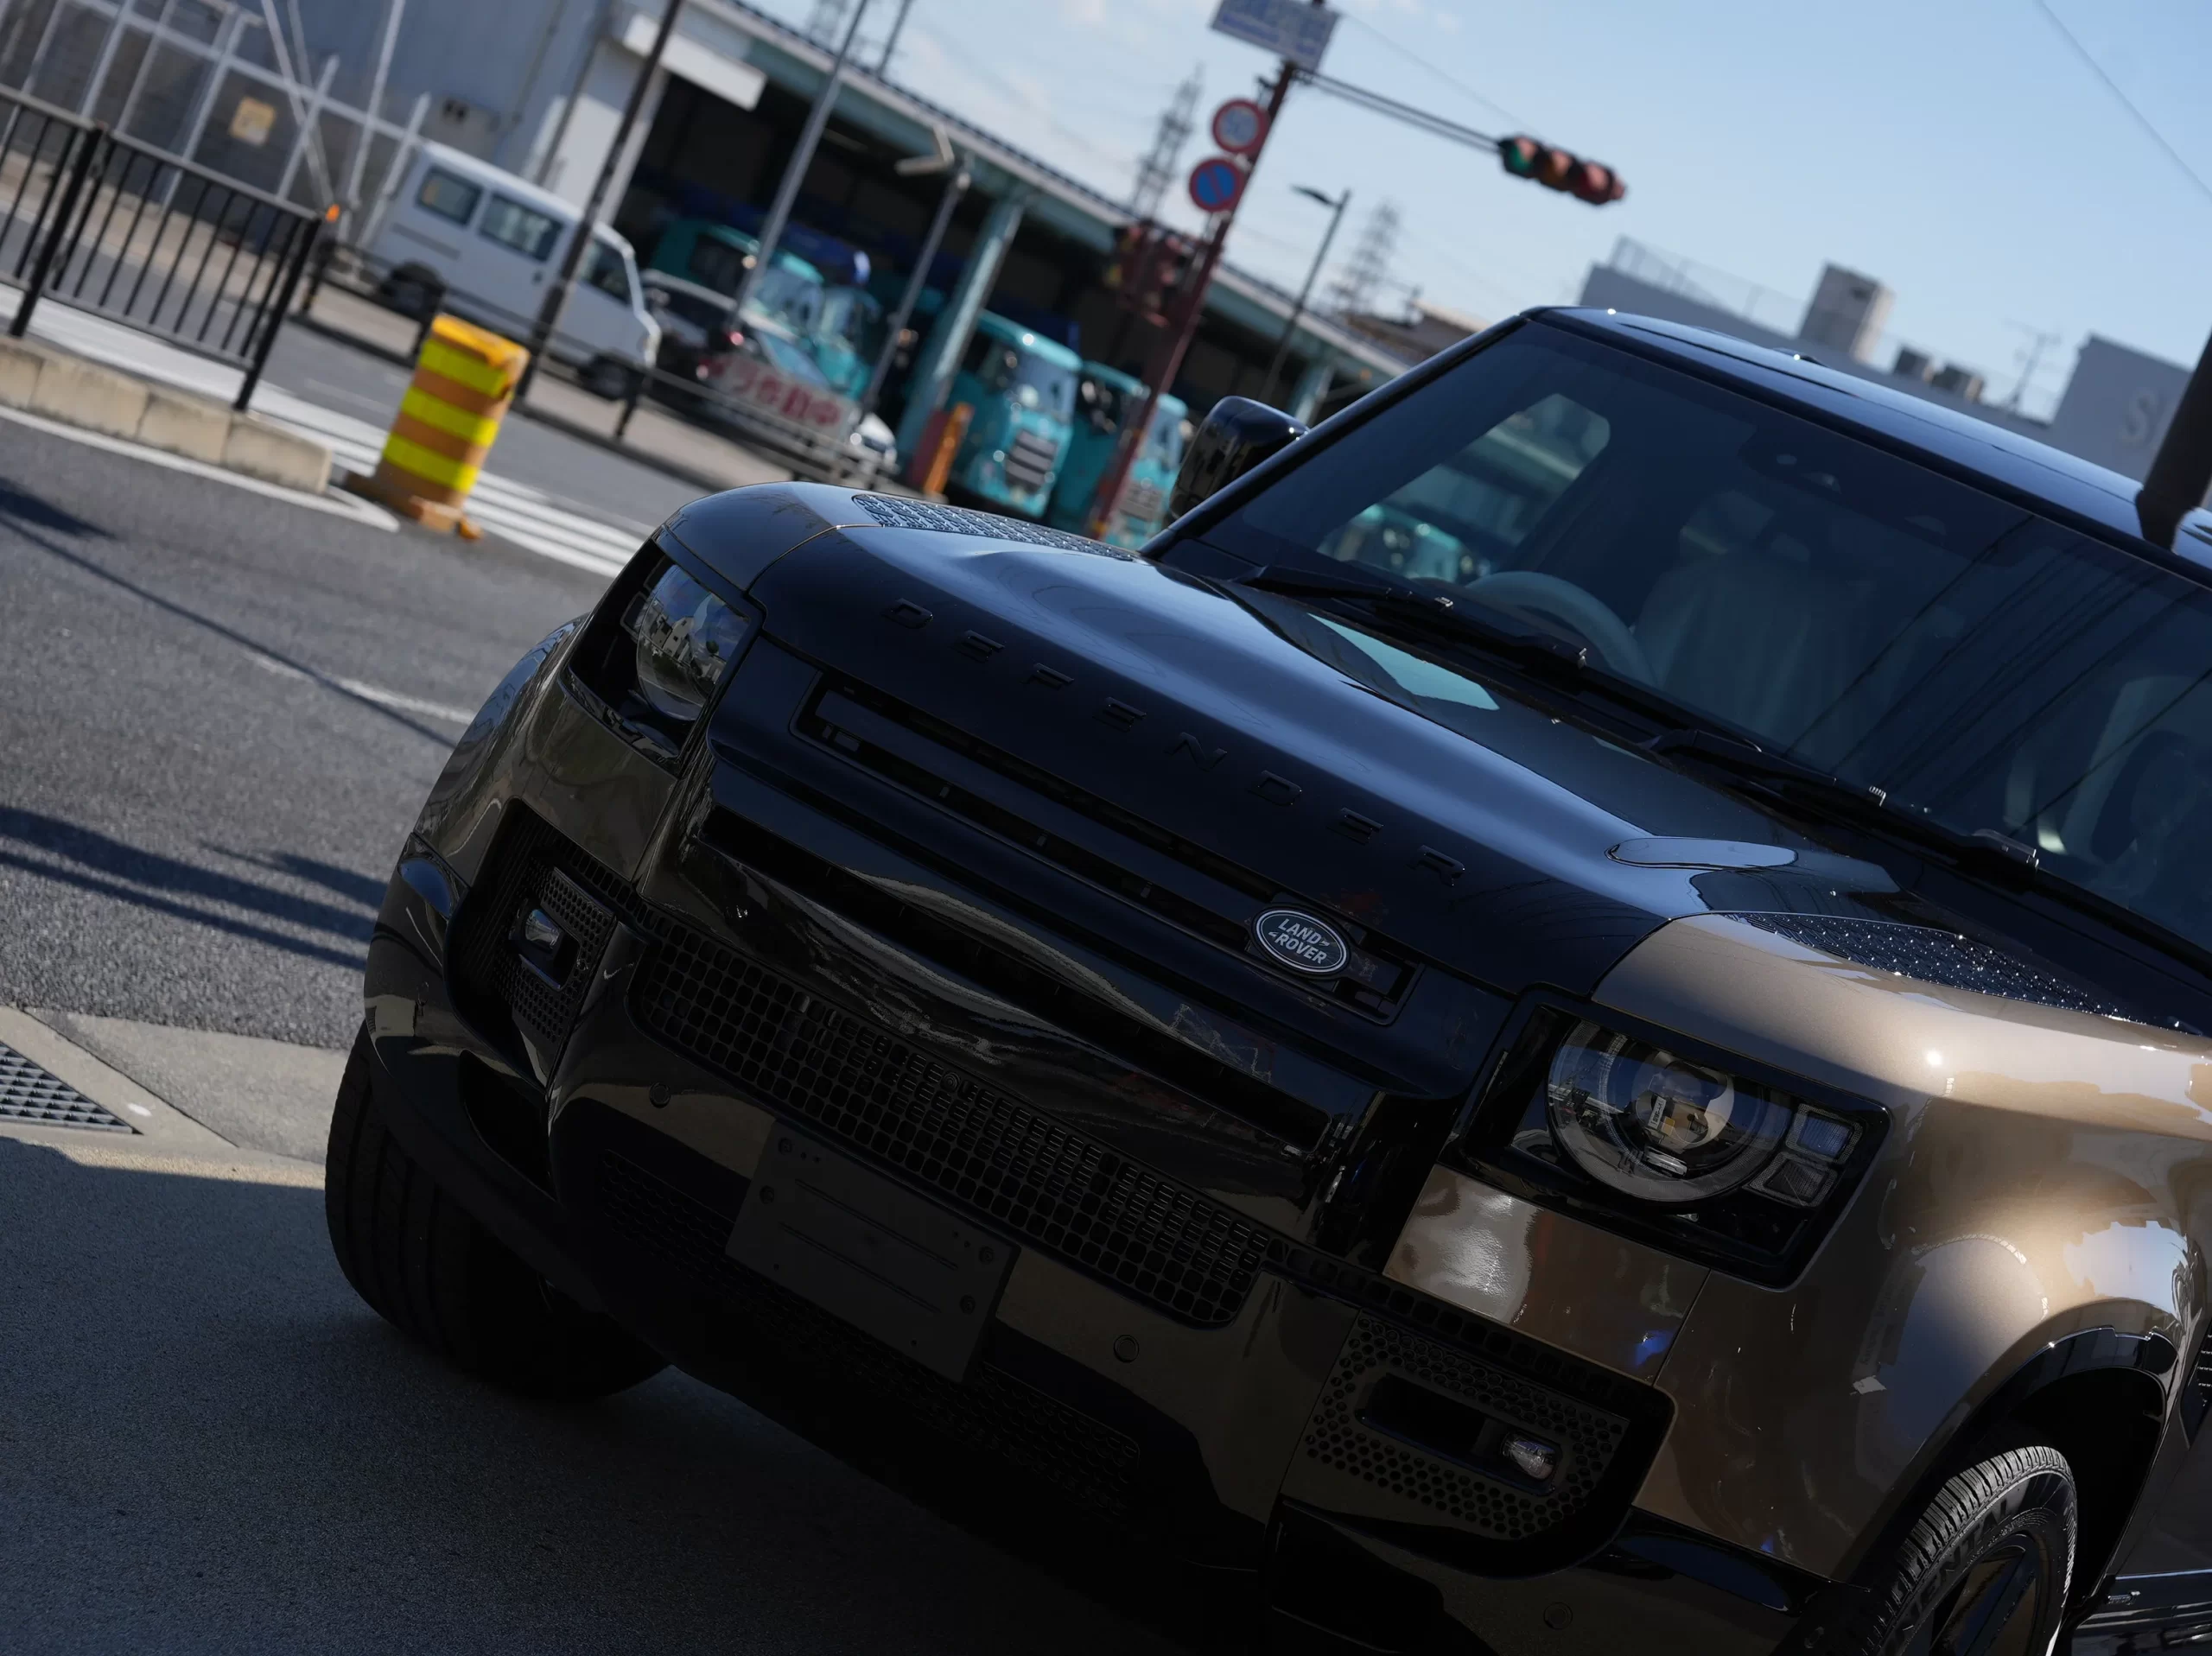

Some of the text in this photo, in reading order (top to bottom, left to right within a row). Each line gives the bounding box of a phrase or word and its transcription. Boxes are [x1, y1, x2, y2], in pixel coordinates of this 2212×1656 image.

[880, 598, 1465, 888] DEFENDER
[1278, 918, 1323, 945] LAND
[1274, 933, 1327, 964] ROVER
